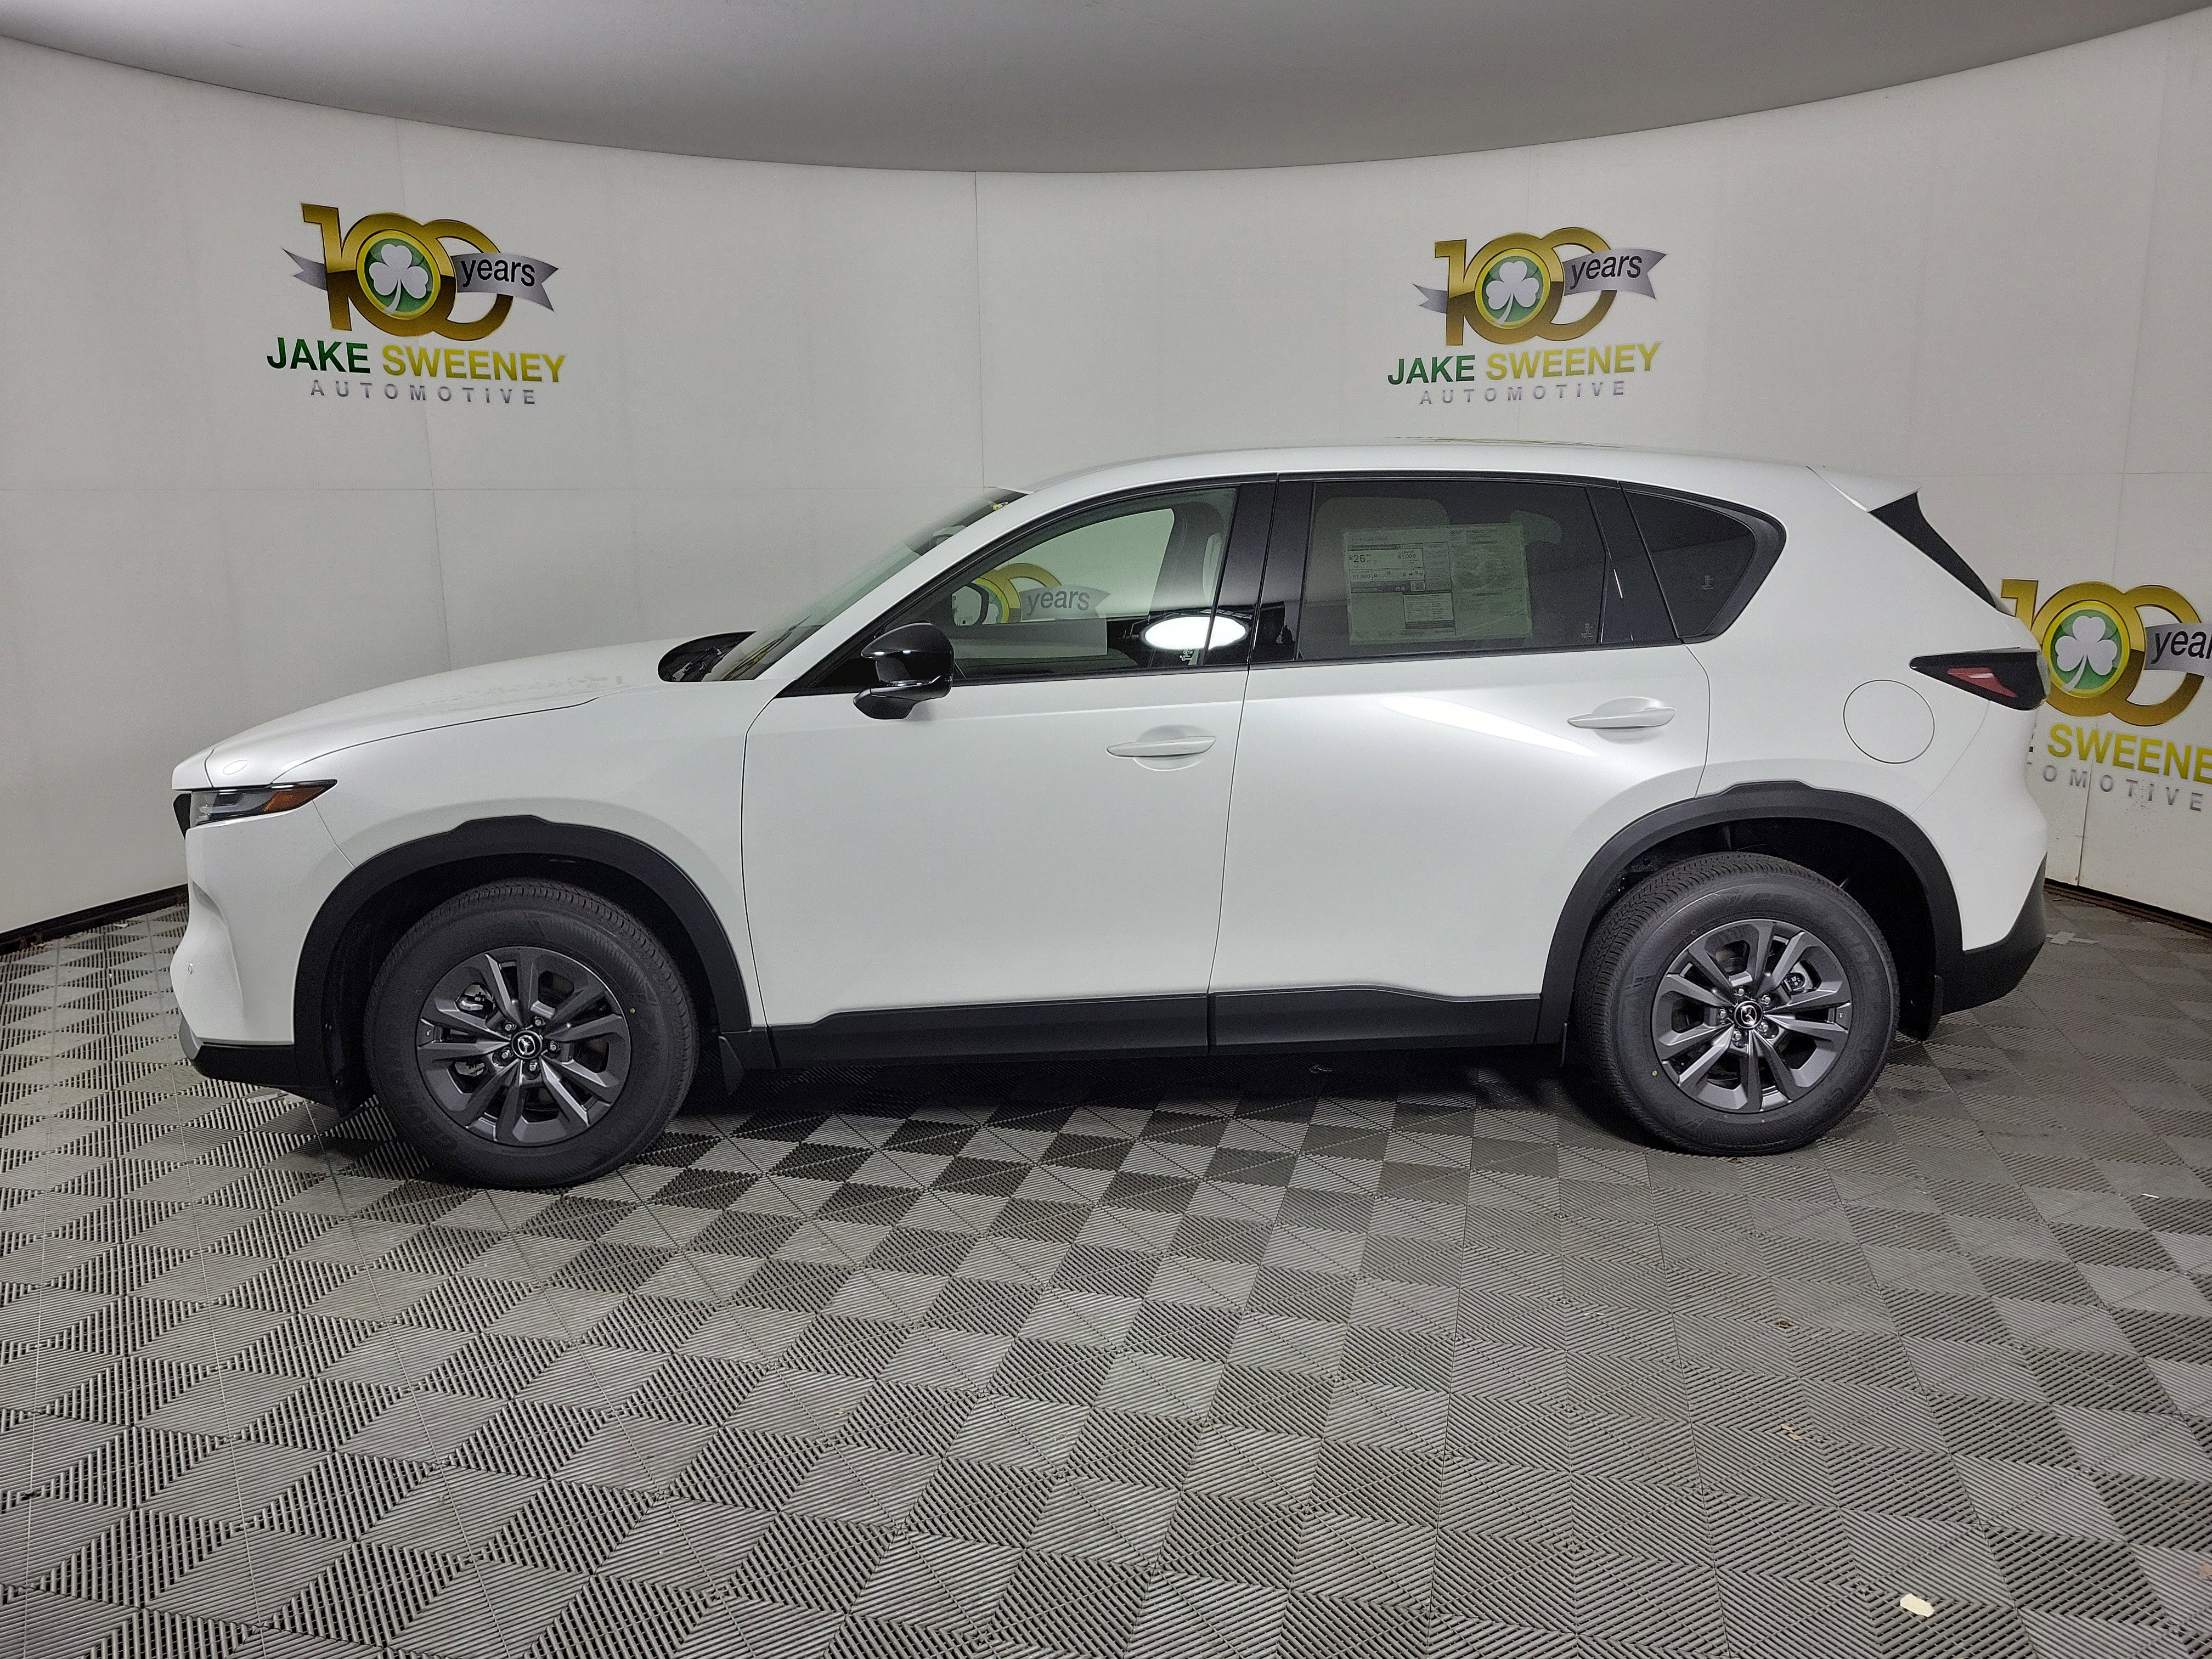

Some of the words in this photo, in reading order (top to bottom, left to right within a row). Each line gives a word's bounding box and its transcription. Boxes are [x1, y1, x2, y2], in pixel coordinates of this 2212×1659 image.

[301, 203, 514, 341] 100
[460, 258, 535, 287] years
[1435, 227, 1618, 346] 100
[1570, 255, 1643, 290] years
[267, 337, 371, 374] JAKE
[383, 345, 566, 383] SWEENEY
[1387, 354, 1476, 385] JAKE
[1486, 342, 1661, 381] SWEENEY
[311, 380, 535, 404] AUTOMOTIVE
[1420, 381, 1625, 405] AUTOMOTIVE
[1353, 555, 1365, 563] 26
[1028, 590, 1090, 616] years
[2027, 761, 2203, 812] OMOTIVE
